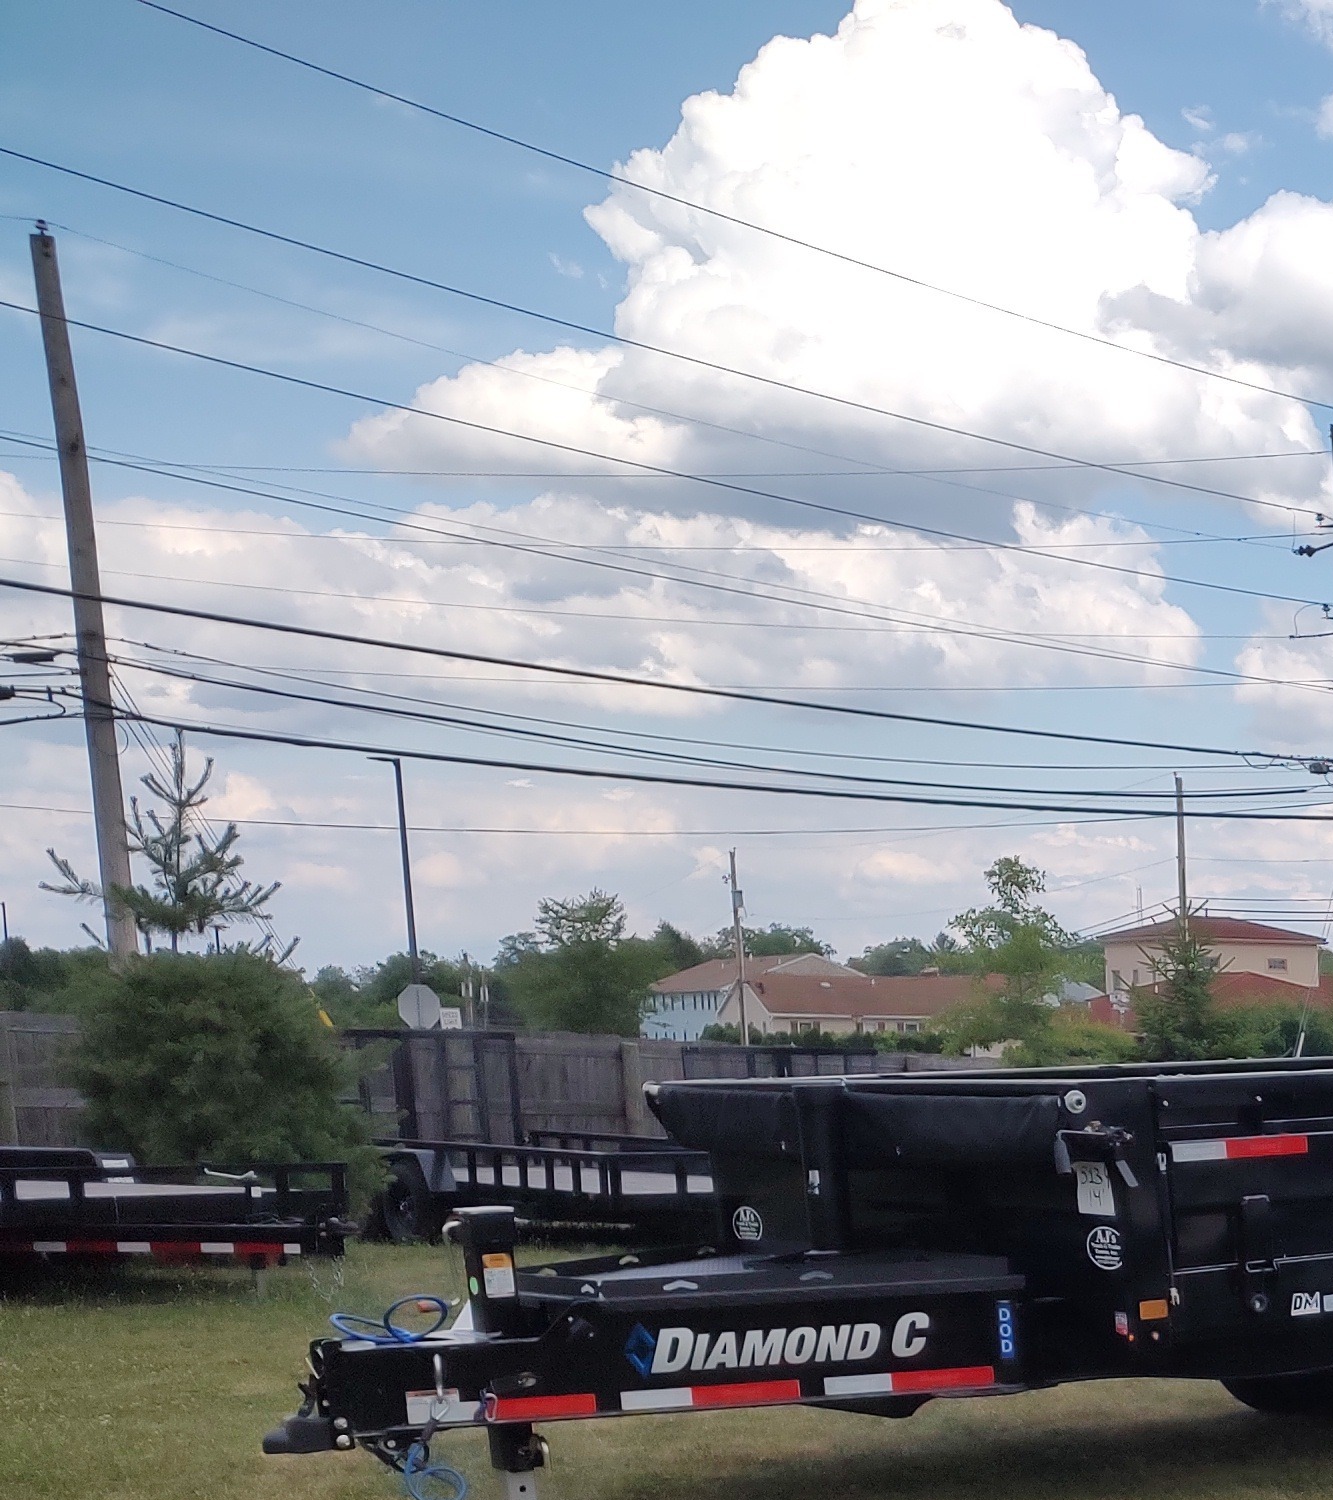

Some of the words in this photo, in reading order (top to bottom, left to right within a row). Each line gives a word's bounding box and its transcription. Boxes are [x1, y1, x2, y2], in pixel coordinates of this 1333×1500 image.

[651, 1323, 881, 1374] DIAMOND
[891, 1311, 930, 1358] C
[999, 1307, 1012, 1353] DOD
